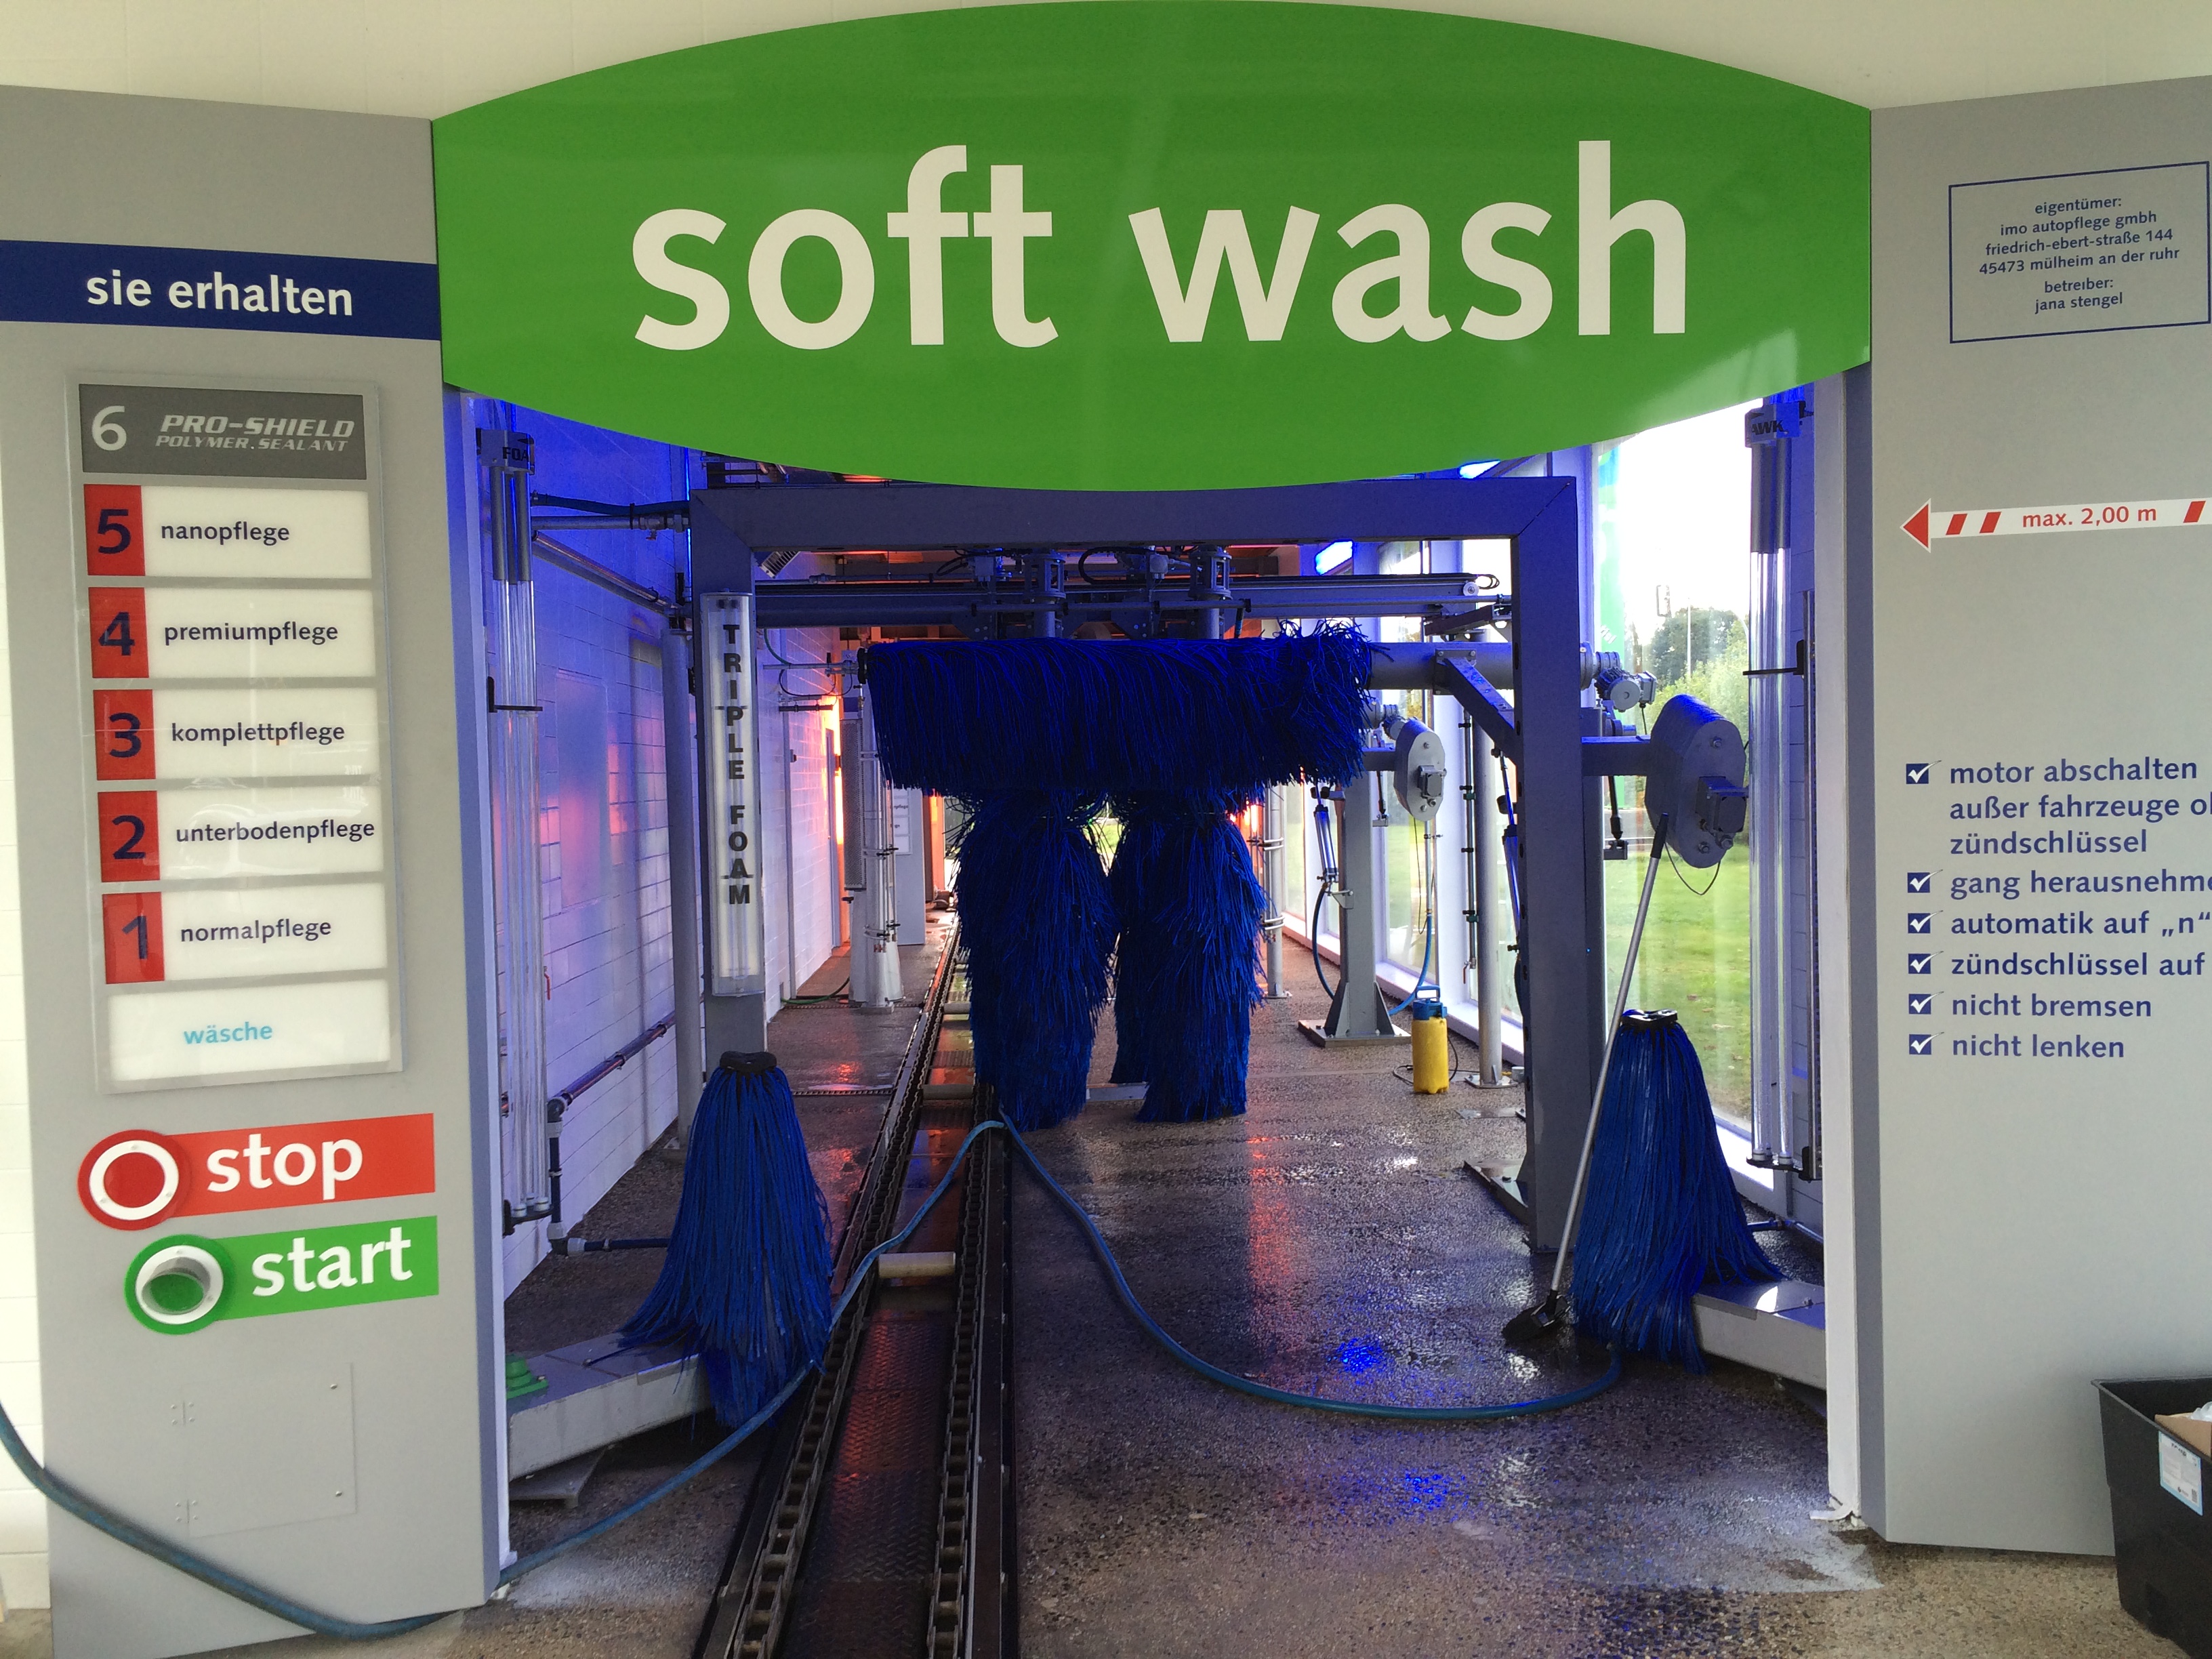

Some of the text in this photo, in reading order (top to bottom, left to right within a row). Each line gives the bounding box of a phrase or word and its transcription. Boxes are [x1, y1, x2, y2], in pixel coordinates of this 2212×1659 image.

[2035, 197, 2122, 216] eigentümer:
[2001, 211, 2156, 235] imo autopflege gmbh
[633, 140, 1685, 350] soft wash
[1986, 228, 2173, 255] friedrich-ebert-straße 144
[1980, 247, 2179, 274] 45473 mülheim an der ruhr
[87, 270, 352, 315] sie erhalten
[2035, 292, 2123, 314] jana stengel
[91, 406, 354, 450] 6 PRO-SHIELD
[2024, 506, 2156, 527] max. 2,00 m
[98, 509, 289, 554] 5 nanopflege
[98, 612, 337, 655] 4 premiumpflege
[108, 712, 344, 758] 3 komplettpflege
[722, 624, 750, 905] TRIPLE FOAM
[1951, 756, 2196, 783] motor abschalten
[1950, 792, 2212, 823] außer fahrzeuge o
[112, 815, 374, 859] 2 unterbodenpflege
[1950, 829, 2146, 854] zündschlüssel
[1951, 869, 2212, 900] gang herausnehm
[1952, 911, 2093, 934] automatik
[2104, 910, 2149, 934] auf
[122, 914, 331, 960] 1 normalpflege
[1952, 952, 2205, 975] zündschlüssel auf
[1953, 993, 2150, 1017] nicht bremsen
[184, 1021, 272, 1044] wäsche
[1953, 1033, 2123, 1058] nicht lenken
[207, 1134, 363, 1200] stop
[251, 1227, 413, 1296] start
